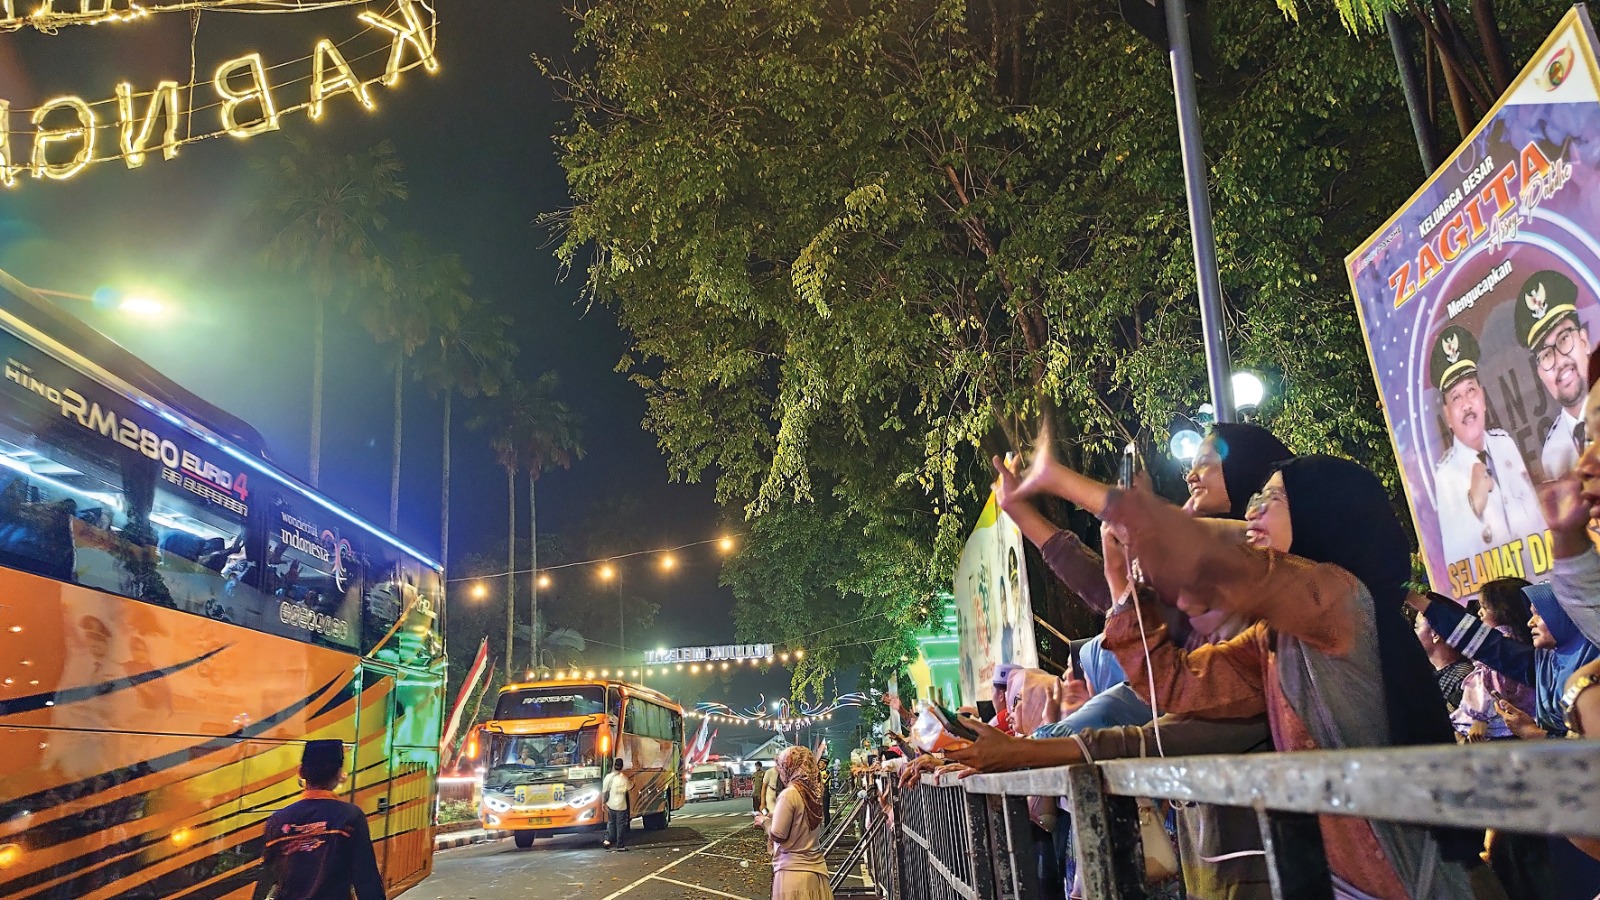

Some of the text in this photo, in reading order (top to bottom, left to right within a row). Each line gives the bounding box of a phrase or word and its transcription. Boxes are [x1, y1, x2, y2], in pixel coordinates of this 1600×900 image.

[1389, 141, 1552, 310] ZAGITA
[1418, 155, 1495, 239] KELUARGA BESAR
[1447, 259, 1513, 319] Mengucapkan
[5, 365, 61, 407] HINO
[181, 450, 234, 491] EURO
[233, 472, 248, 502] 4
[1448, 540, 1526, 600] SELAMAT
[553, 791, 563, 801] 02
